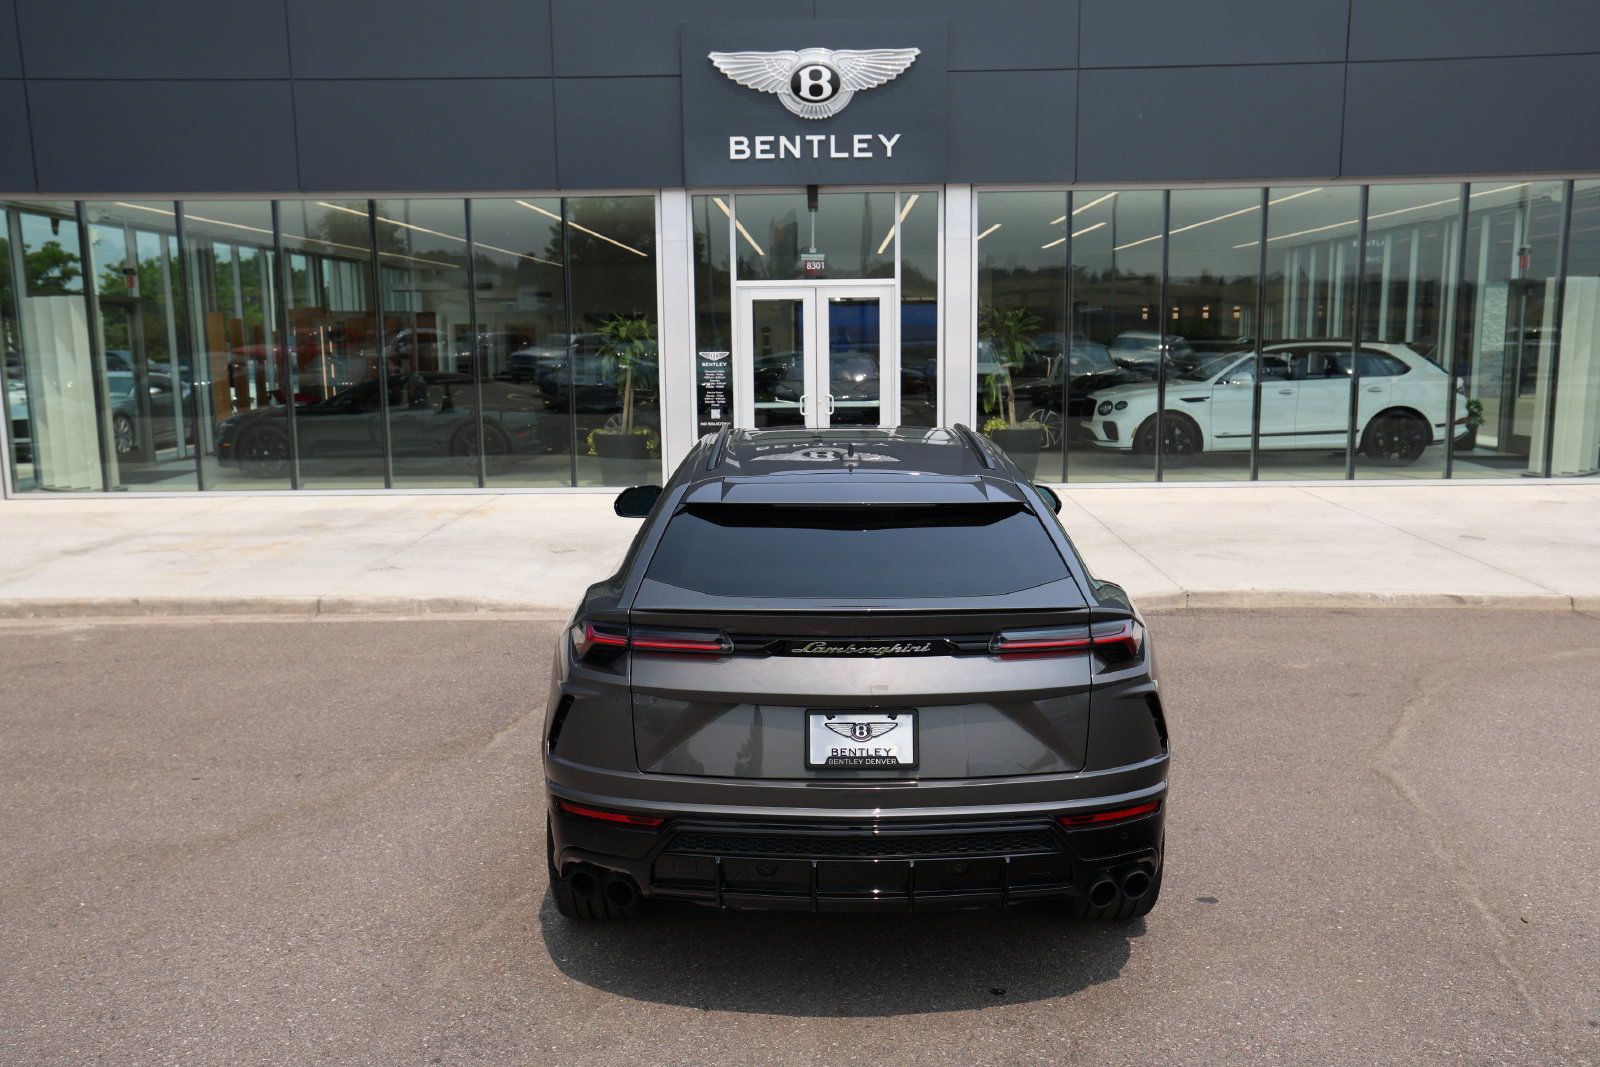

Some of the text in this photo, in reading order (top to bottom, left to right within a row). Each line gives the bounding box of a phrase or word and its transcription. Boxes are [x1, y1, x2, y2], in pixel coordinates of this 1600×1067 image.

[799, 65, 833, 101] B
[728, 133, 902, 160] BENTLEY
[806, 261, 825, 270] 8301
[791, 641, 932, 656] Lamborghini
[831, 748, 891, 756] BENTLEY
